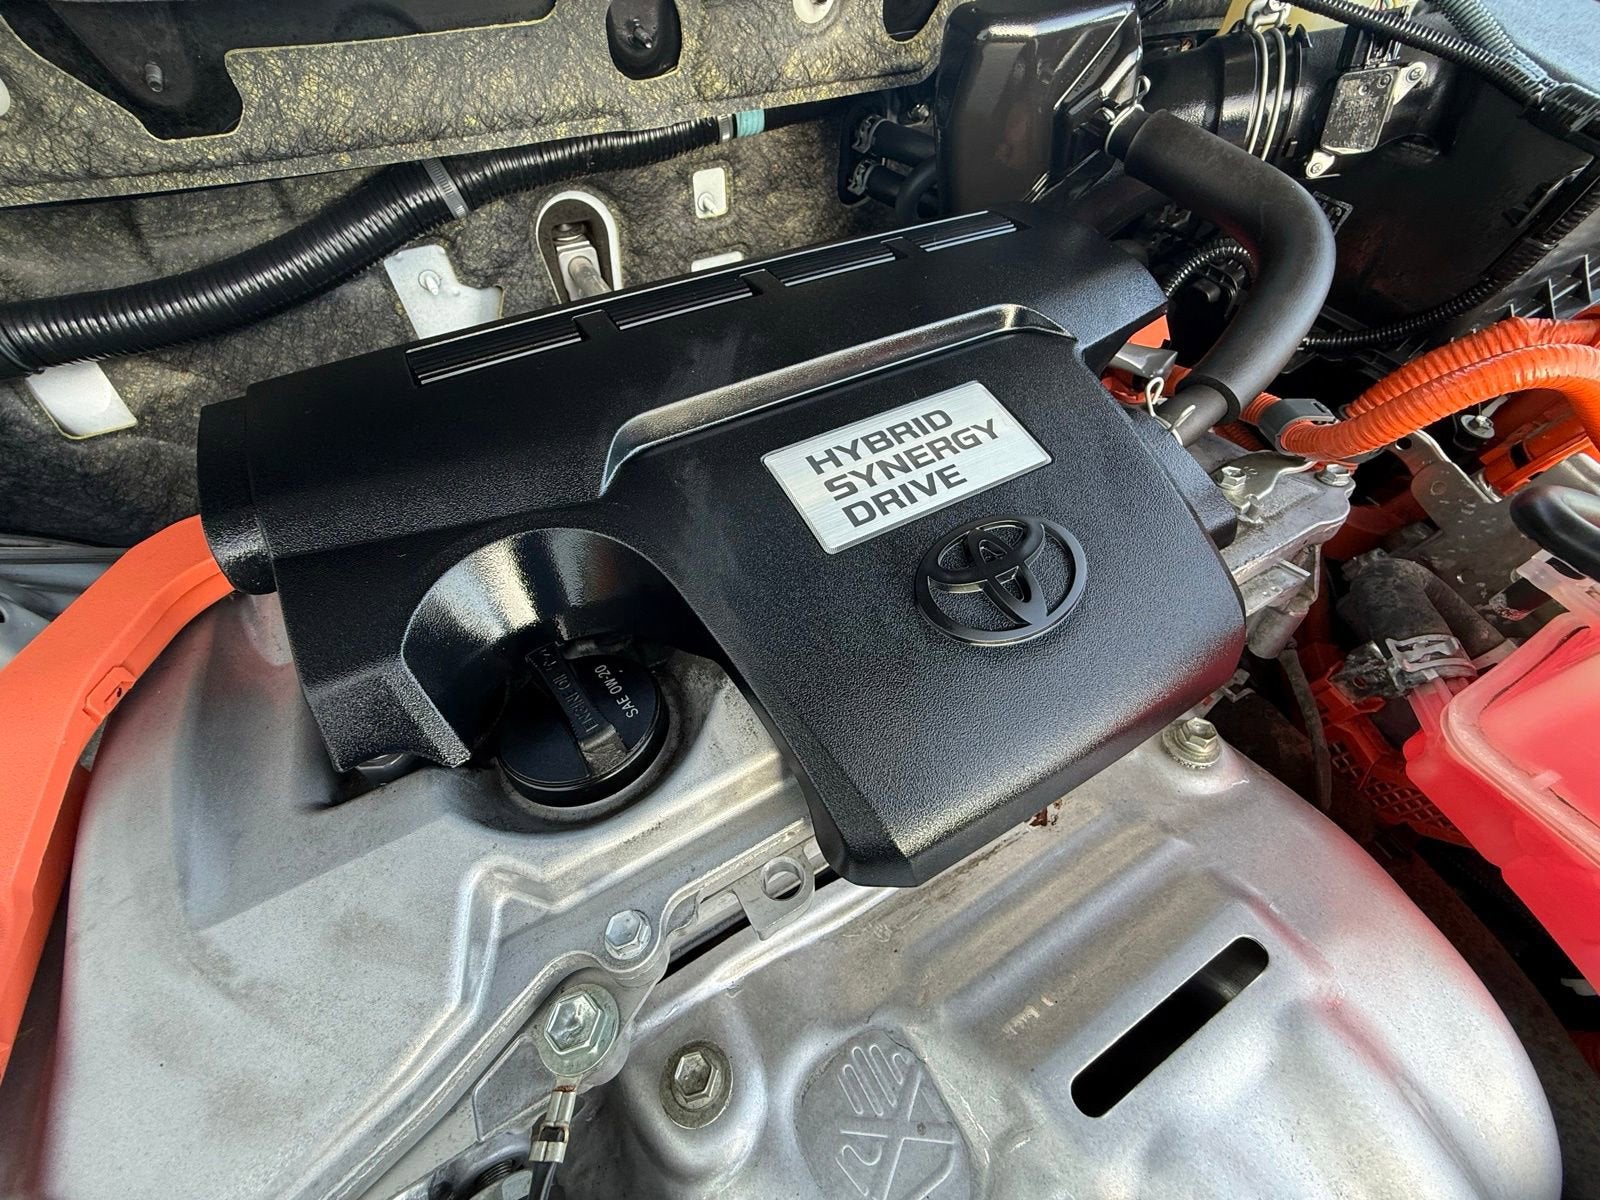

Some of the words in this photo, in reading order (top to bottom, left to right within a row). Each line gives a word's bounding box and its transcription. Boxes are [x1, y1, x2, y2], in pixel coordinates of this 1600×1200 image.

[805, 409, 953, 475] HYBRID
[823, 418, 999, 501] SYNERGY
[841, 464, 968, 527] DRIVE
[594, 664, 623, 694] 0W-20
[616, 694, 639, 718] SAE
